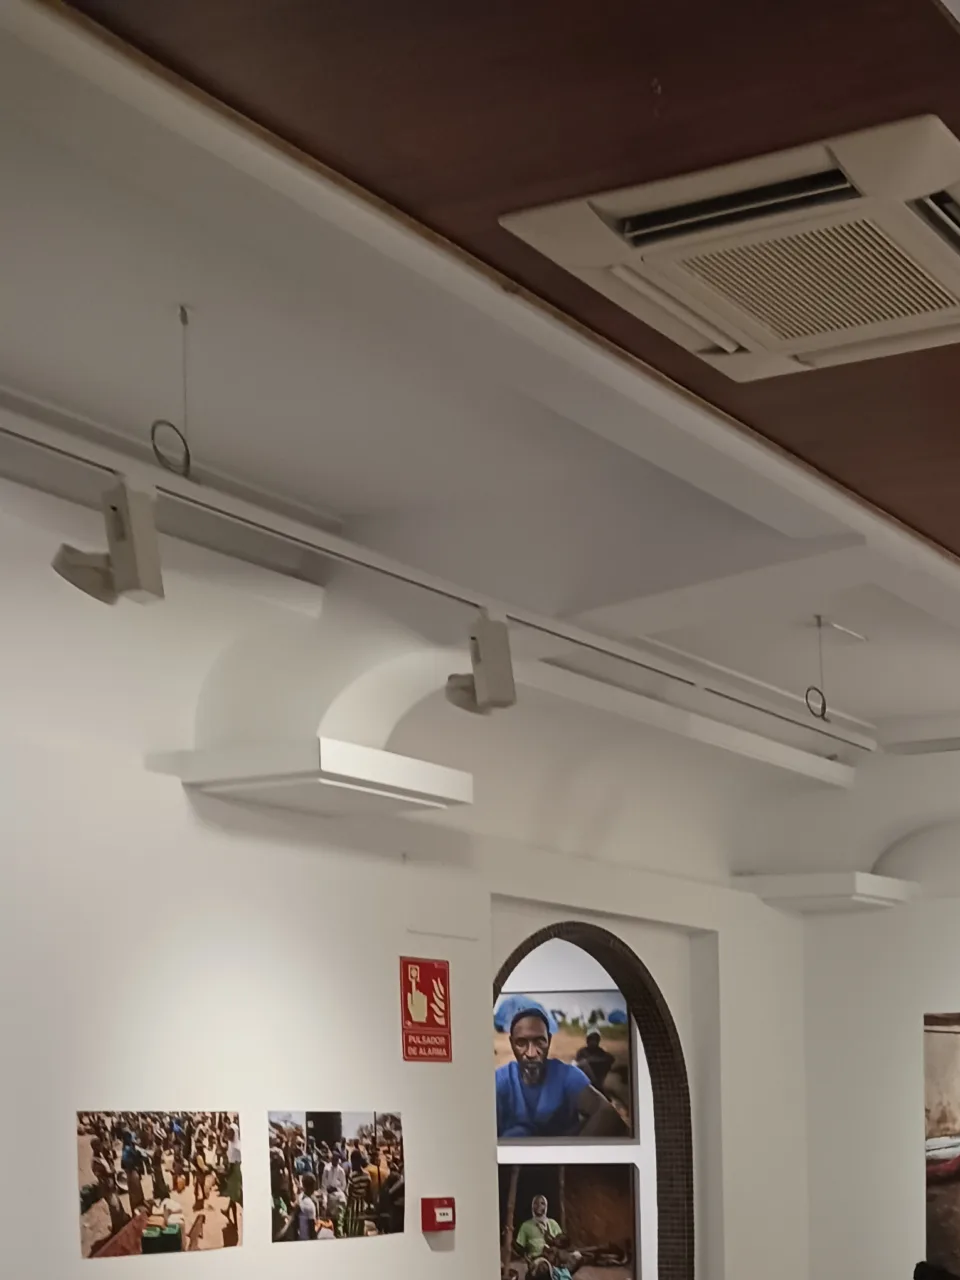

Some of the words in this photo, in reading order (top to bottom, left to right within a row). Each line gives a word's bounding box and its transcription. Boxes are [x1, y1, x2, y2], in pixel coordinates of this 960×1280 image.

[408, 1034, 446, 1045] PULSADOR
[407, 1046, 418, 1056] DE
[418, 1047, 447, 1056] ALARMA
